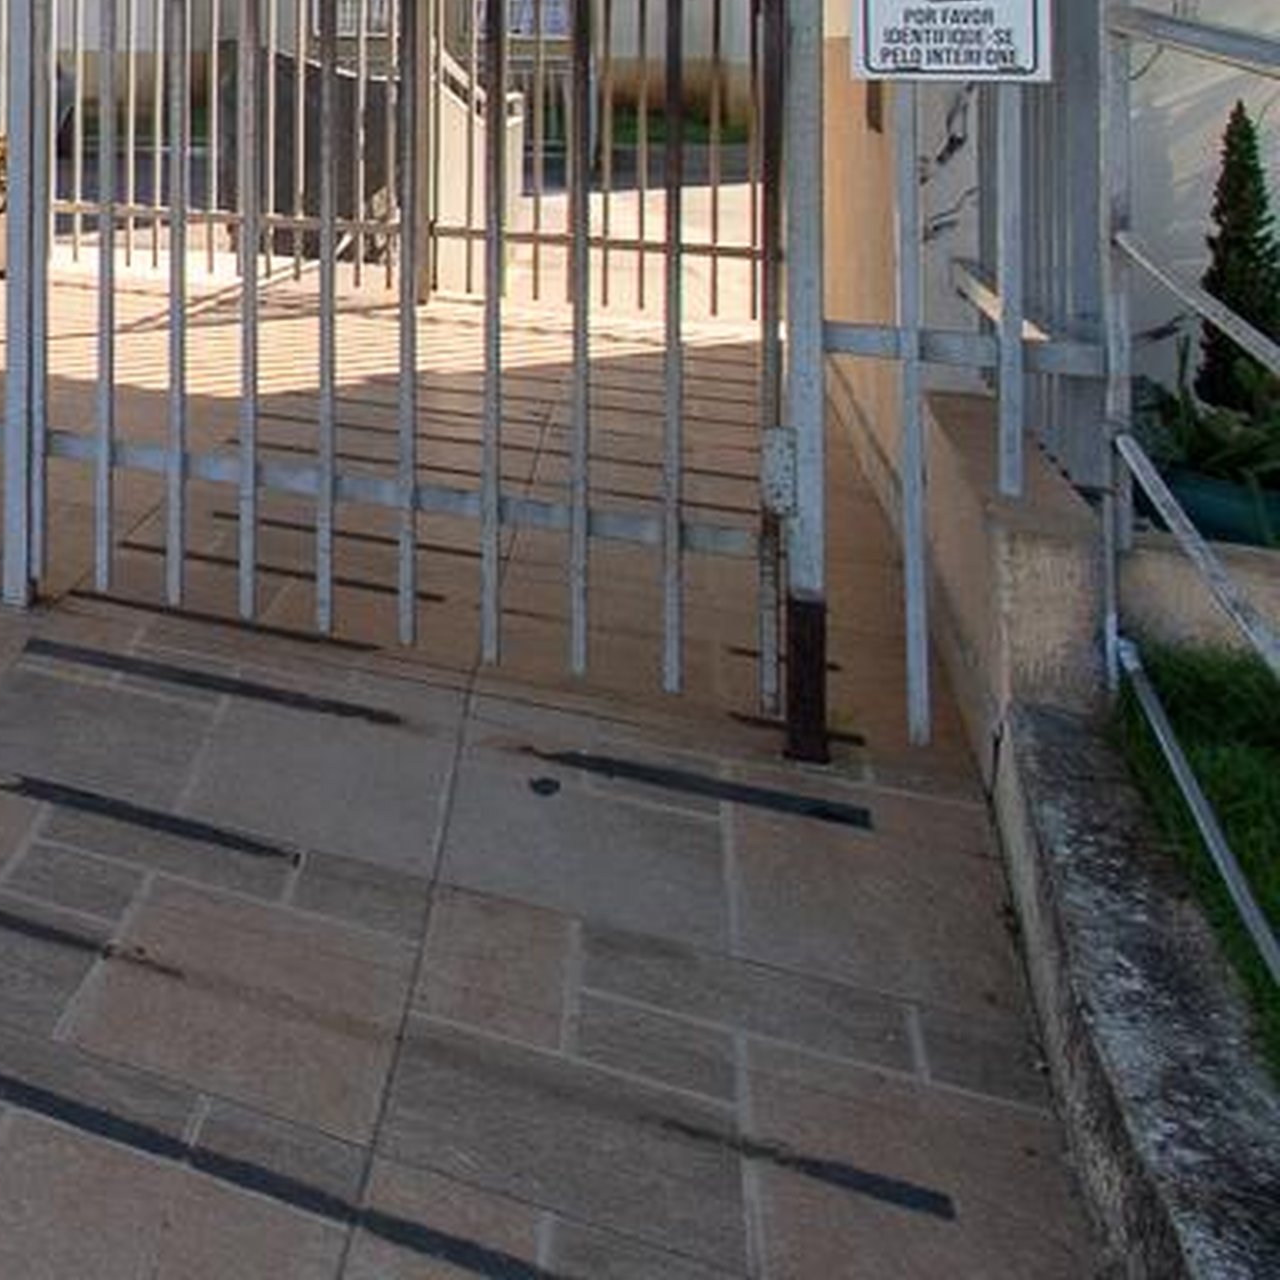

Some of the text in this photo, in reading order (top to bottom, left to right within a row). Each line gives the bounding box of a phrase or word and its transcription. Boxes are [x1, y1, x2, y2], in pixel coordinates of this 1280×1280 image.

[903, 6, 994, 26] POR FAVOR
[880, 45, 1016, 66] PELO INTERFONE
